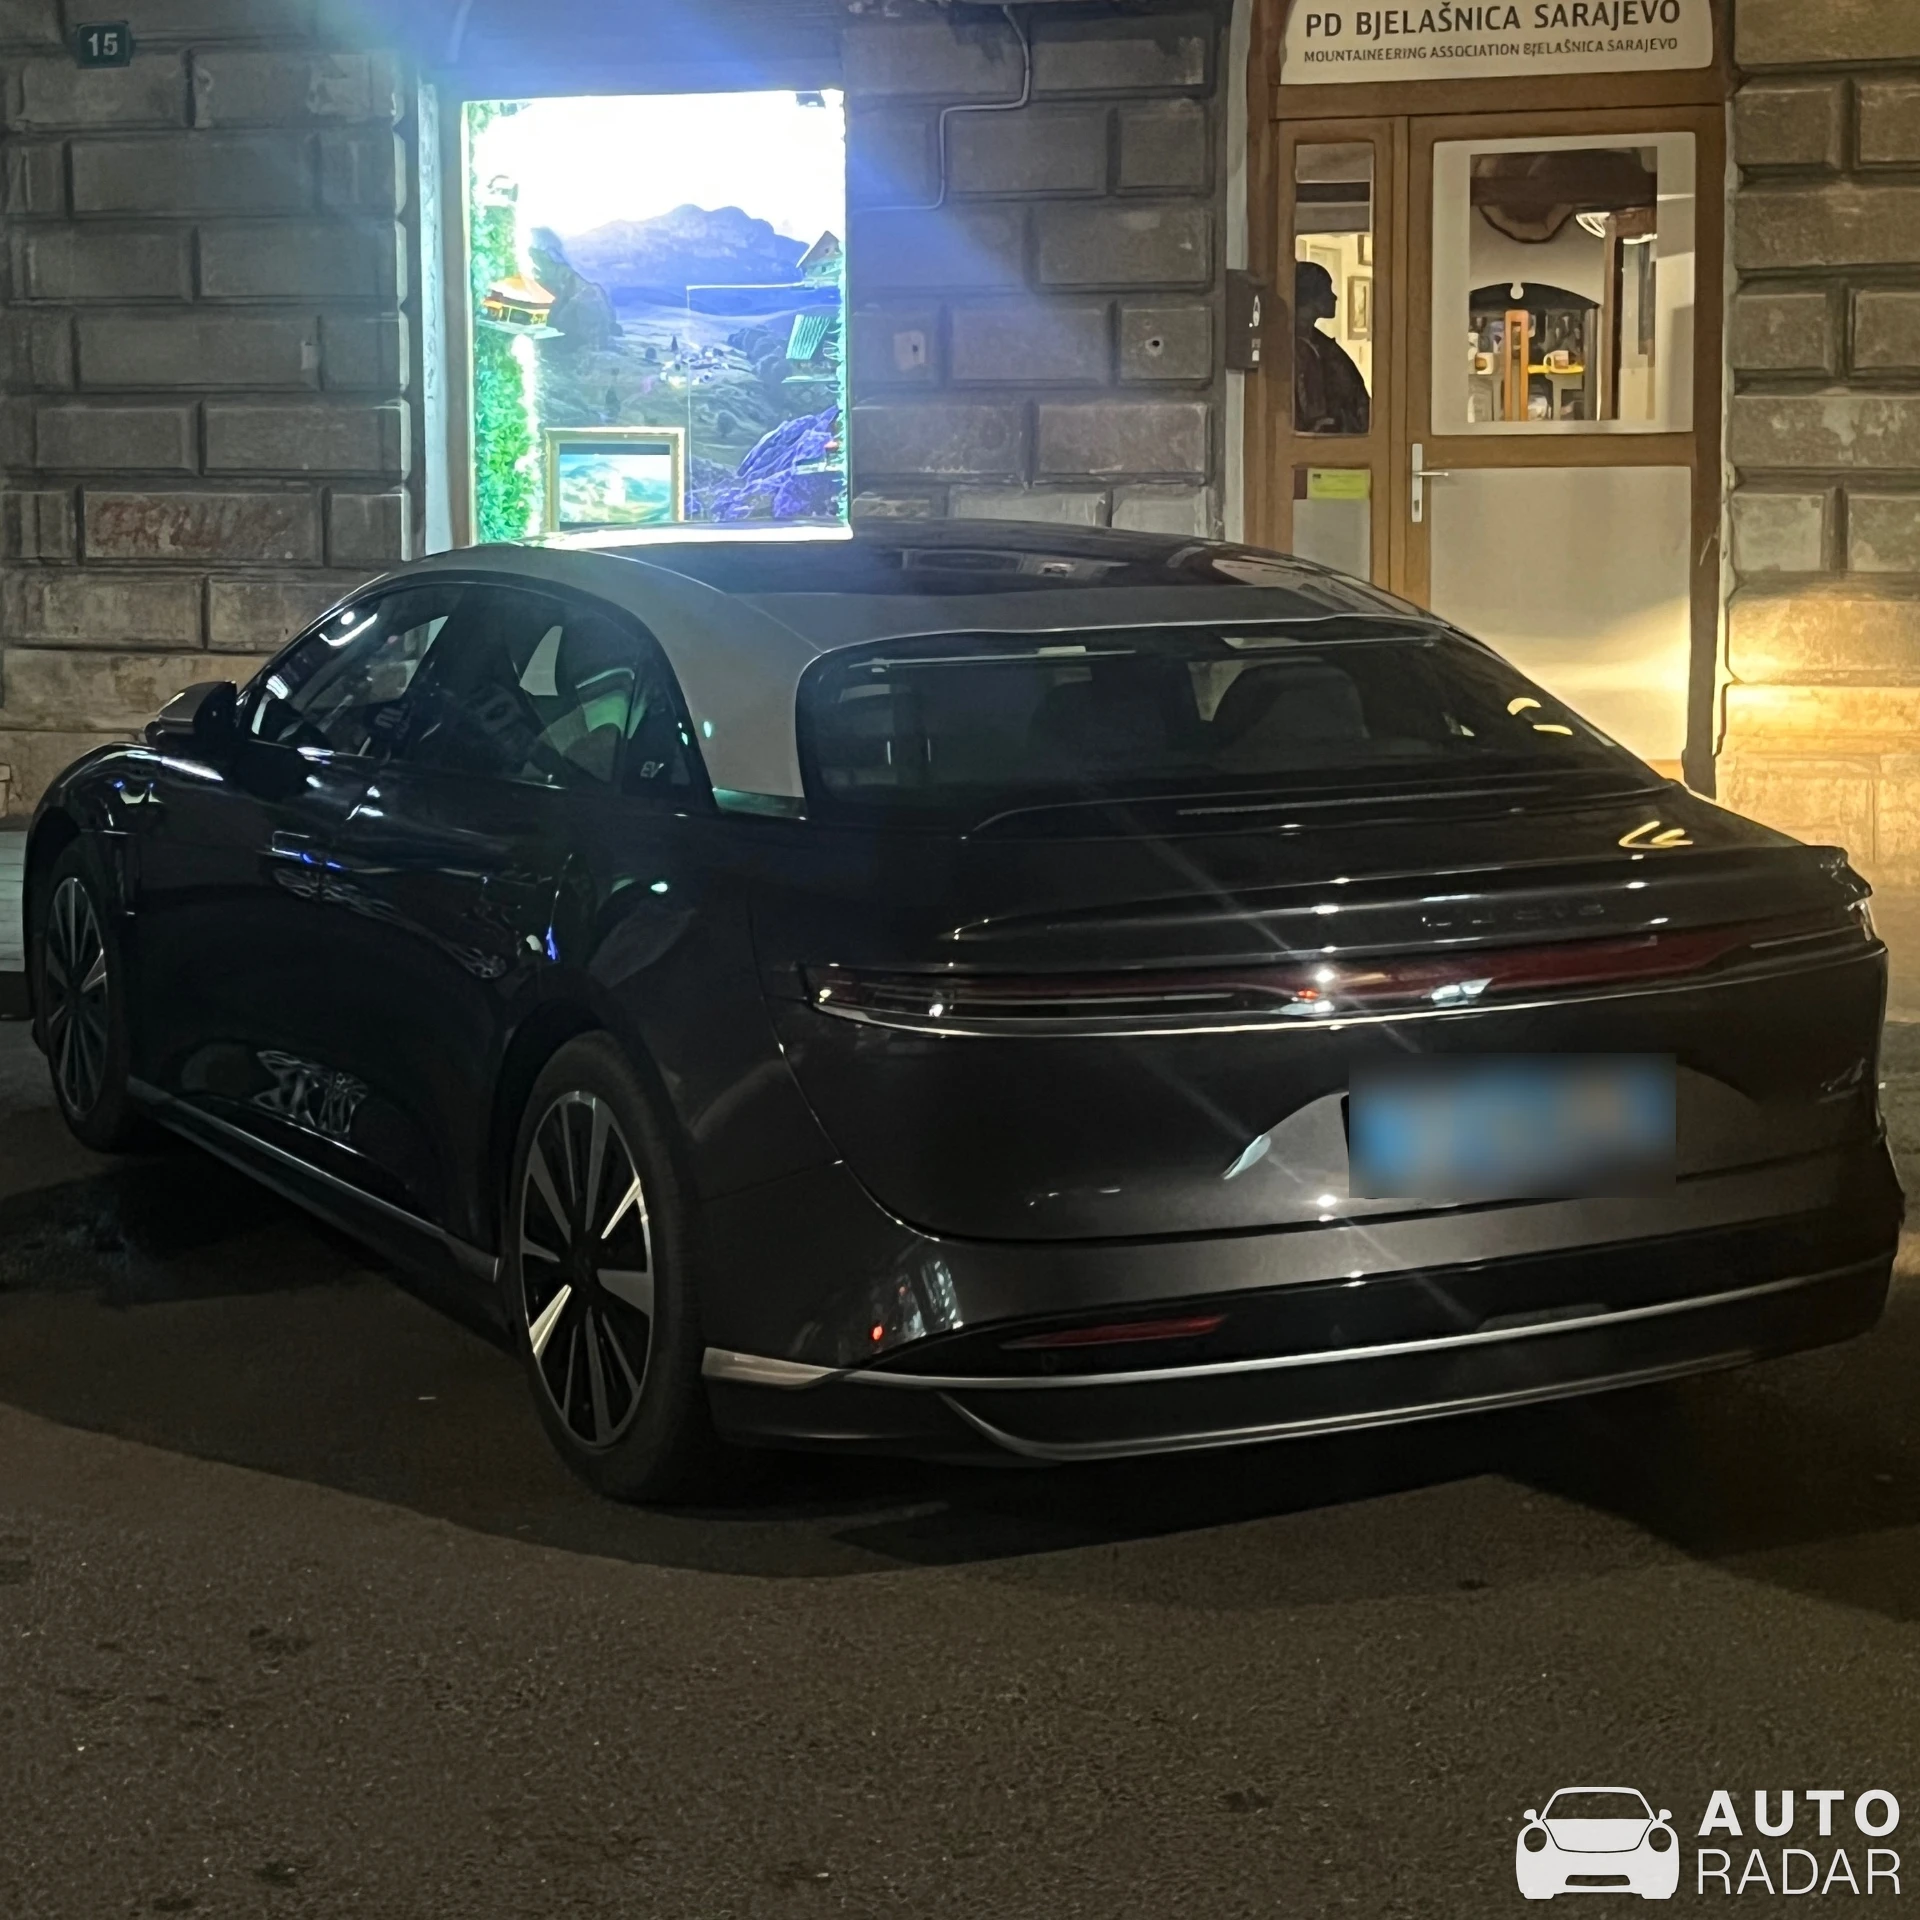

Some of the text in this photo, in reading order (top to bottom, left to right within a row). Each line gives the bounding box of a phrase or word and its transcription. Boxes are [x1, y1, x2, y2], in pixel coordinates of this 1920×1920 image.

[1306, 0, 1681, 41] PD BJELAŠNICA SARAJEVO
[88, 32, 118, 57] 15
[1304, 37, 1678, 63] MOUNTAINEERING ASSOCIATION BJELAŠNICA SARAJEVO
